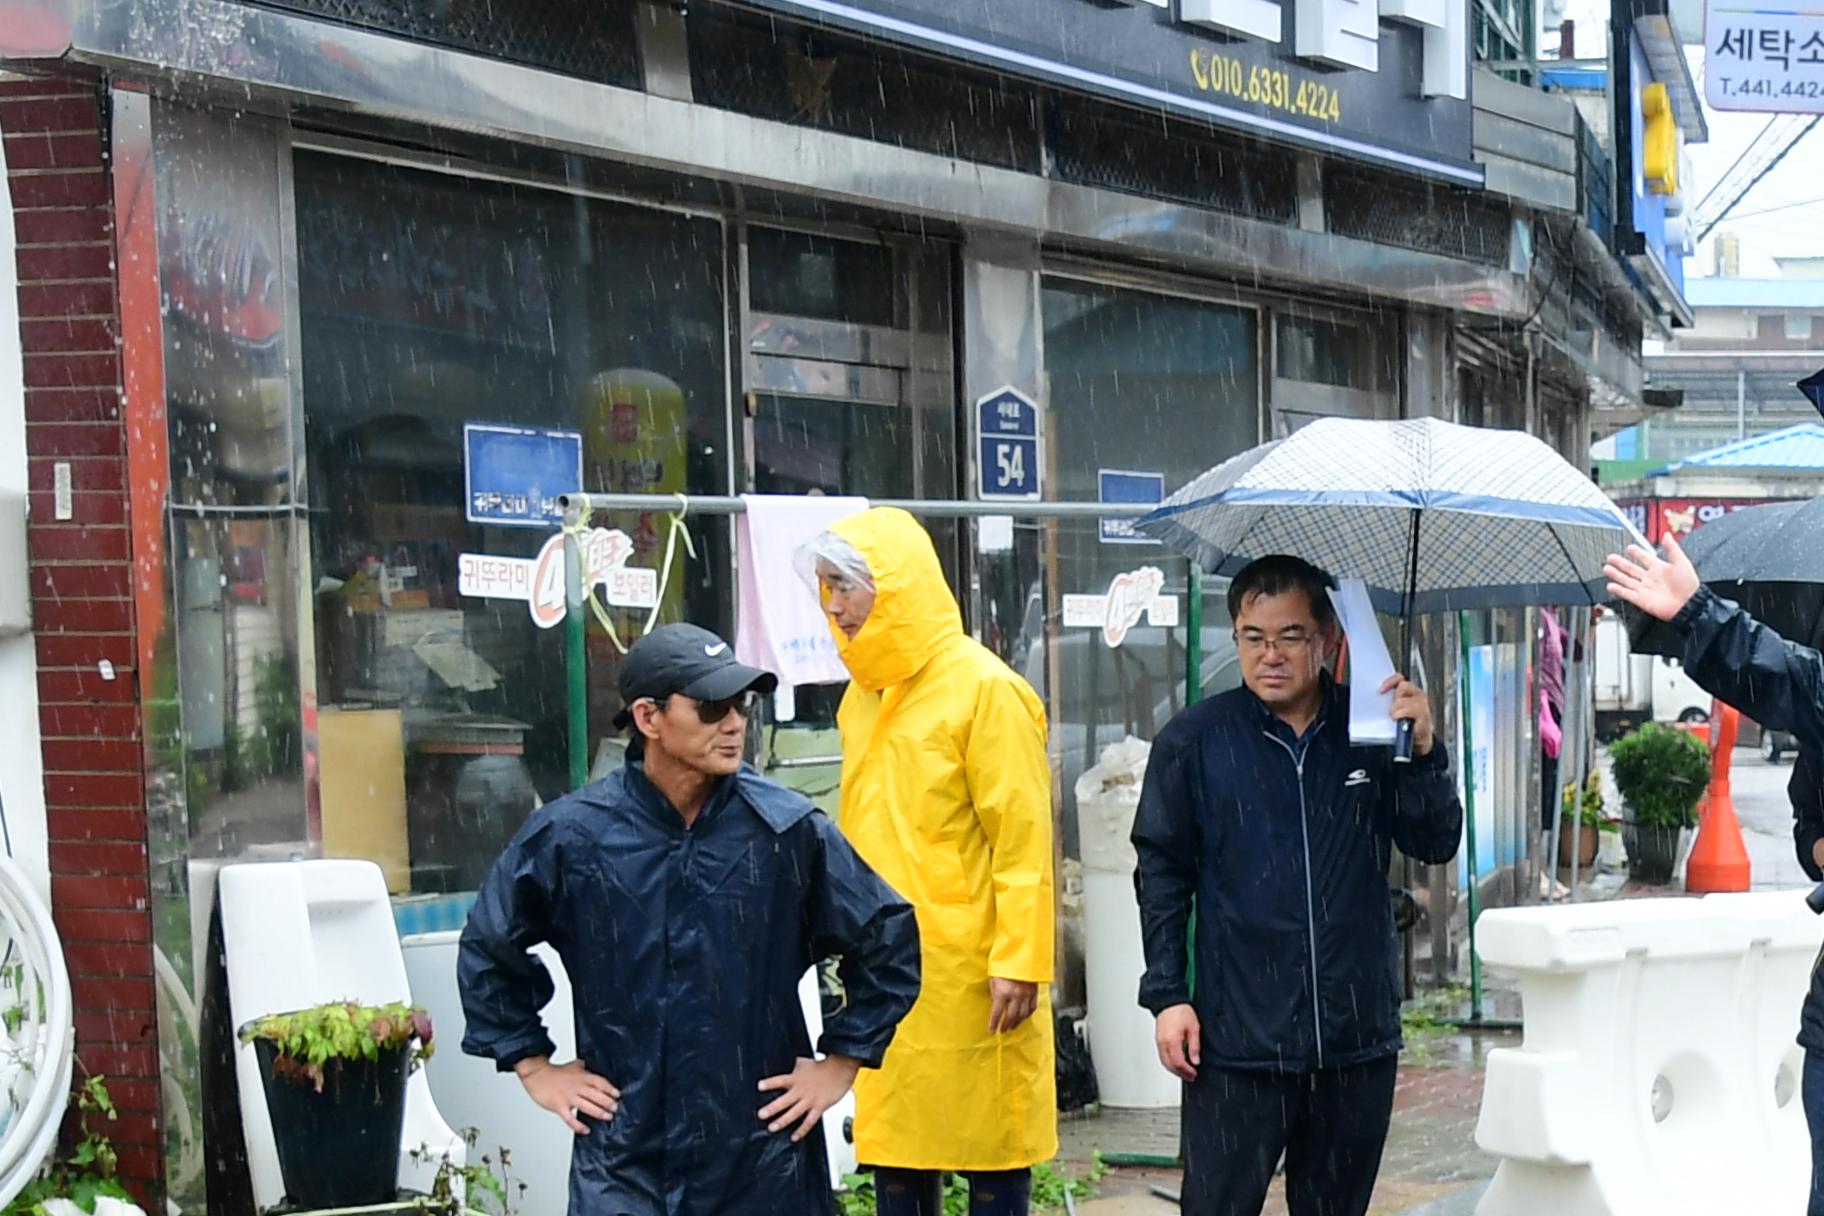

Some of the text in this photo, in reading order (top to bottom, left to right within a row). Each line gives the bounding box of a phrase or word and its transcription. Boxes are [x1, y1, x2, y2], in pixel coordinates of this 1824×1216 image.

[1210, 53, 1341, 124] 010.6331.4224
[997, 444, 1025, 488] 54
[463, 559, 530, 593] 귀뚜라미
[612, 572, 654, 602] 보일러
